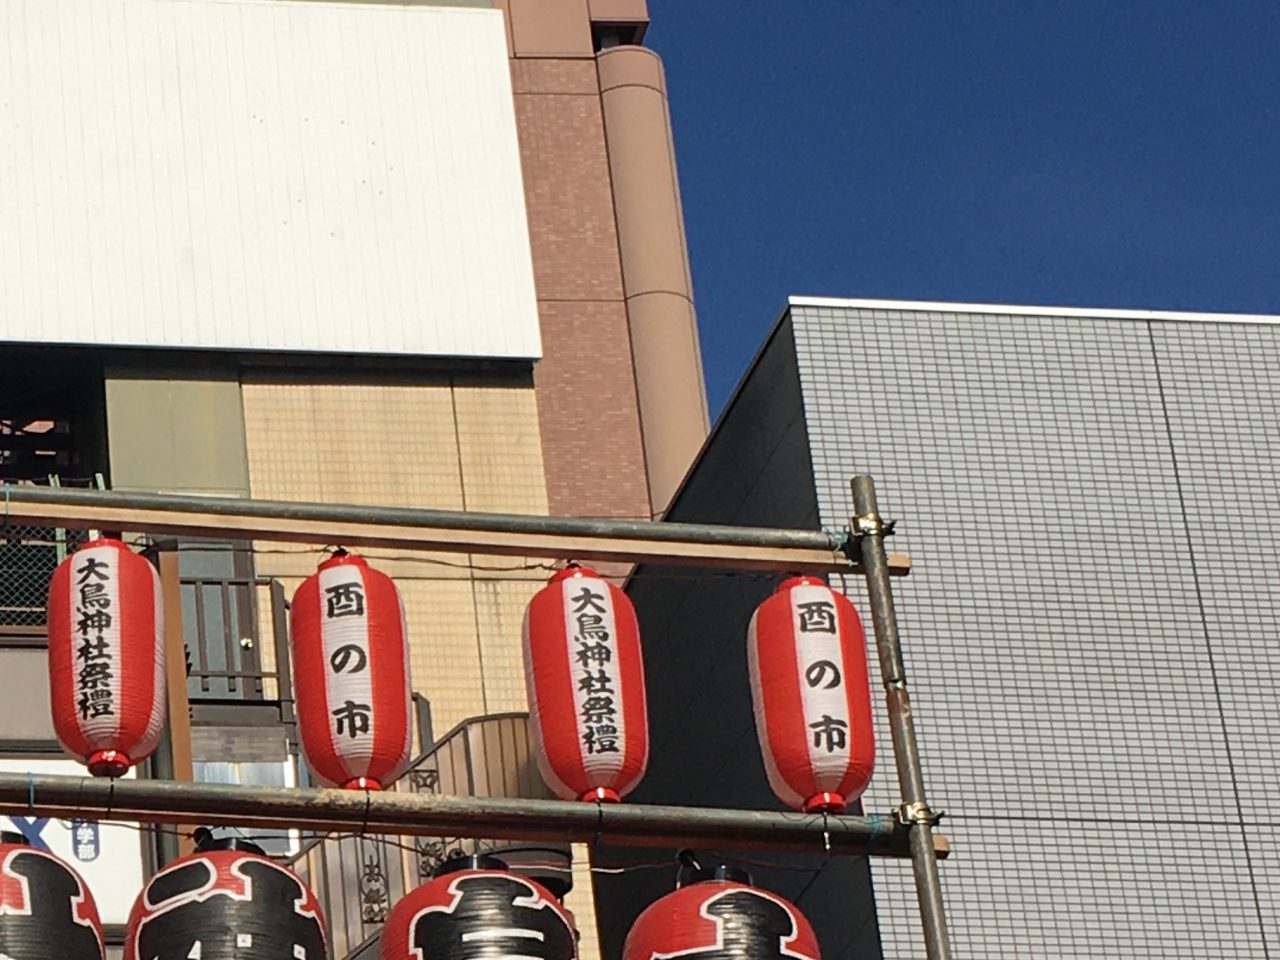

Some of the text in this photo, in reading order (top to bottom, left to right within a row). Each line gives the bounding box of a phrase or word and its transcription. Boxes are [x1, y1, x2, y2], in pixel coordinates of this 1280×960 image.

[76, 556, 115, 721] 大鳥神社祭禮
[325, 581, 372, 739] 酉の市
[571, 586, 620, 754] 大鳥神社祭禮
[797, 600, 848, 753] 酉の市
[74, 819, 97, 860] 学部
